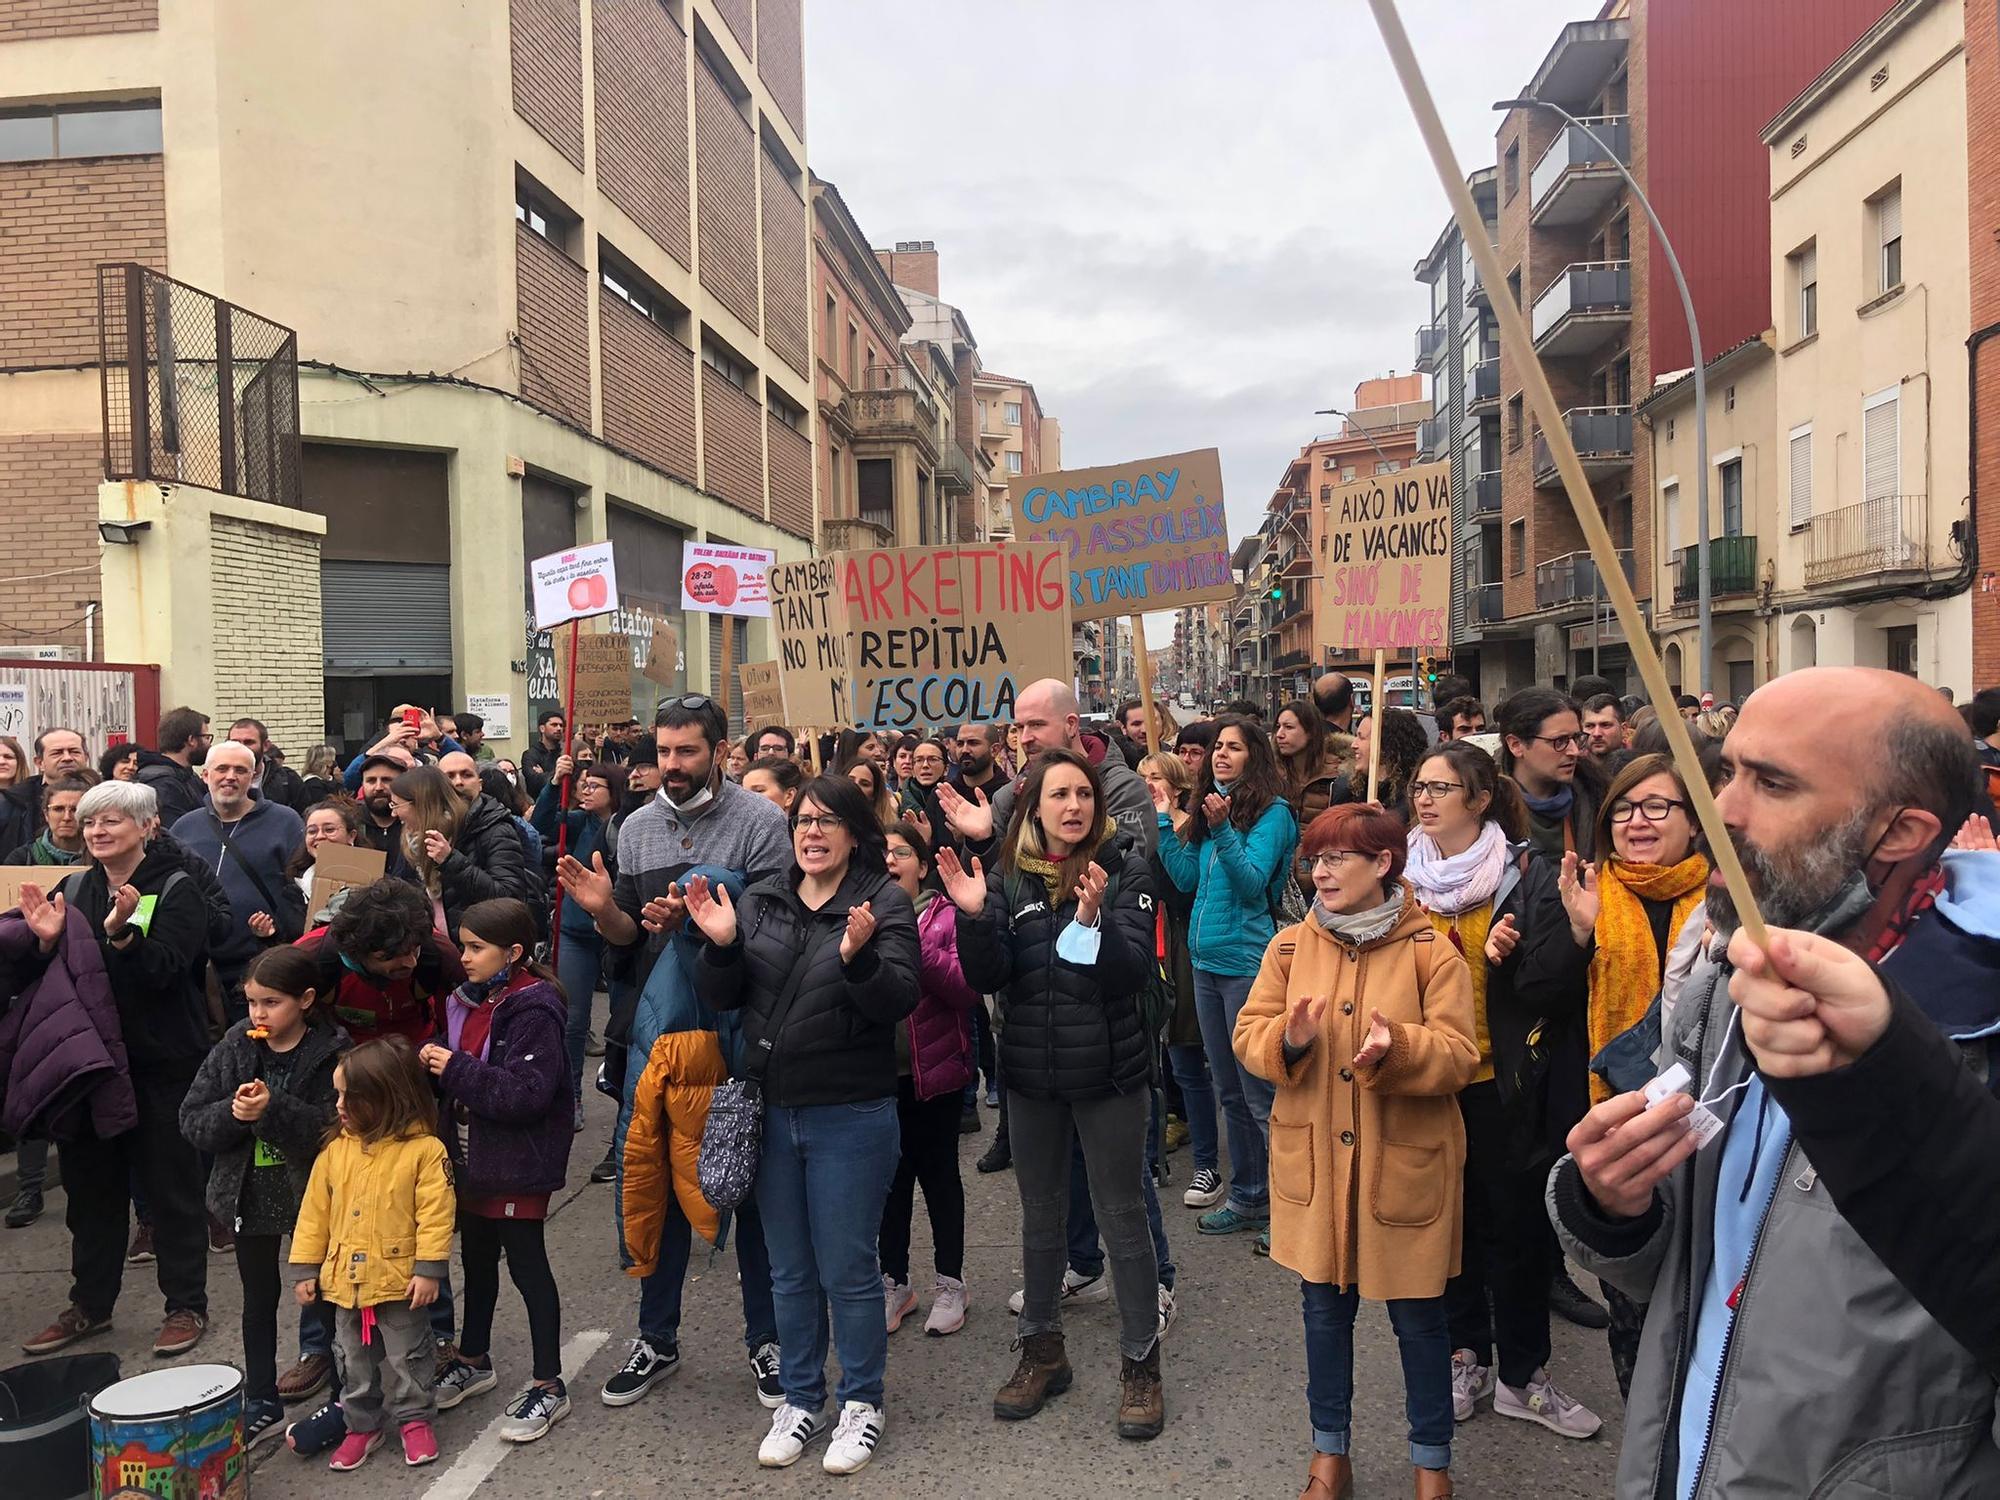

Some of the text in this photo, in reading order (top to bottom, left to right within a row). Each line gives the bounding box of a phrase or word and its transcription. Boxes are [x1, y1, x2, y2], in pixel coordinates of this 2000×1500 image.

[1022, 467, 1180, 523] CAMBRAY
[1340, 475, 1450, 524] AIXÒ NO VA
[1333, 516, 1448, 563] DE VACANCES
[691, 570, 712, 580] 28-29
[771, 552, 836, 595] CAMBRAY
[835, 541, 1065, 623] ARKETING
[1400, 563, 1423, 605] DE
[772, 591, 830, 633] TANT
[782, 637, 807, 671] NO
[1115, 811, 1143, 824] FOX
